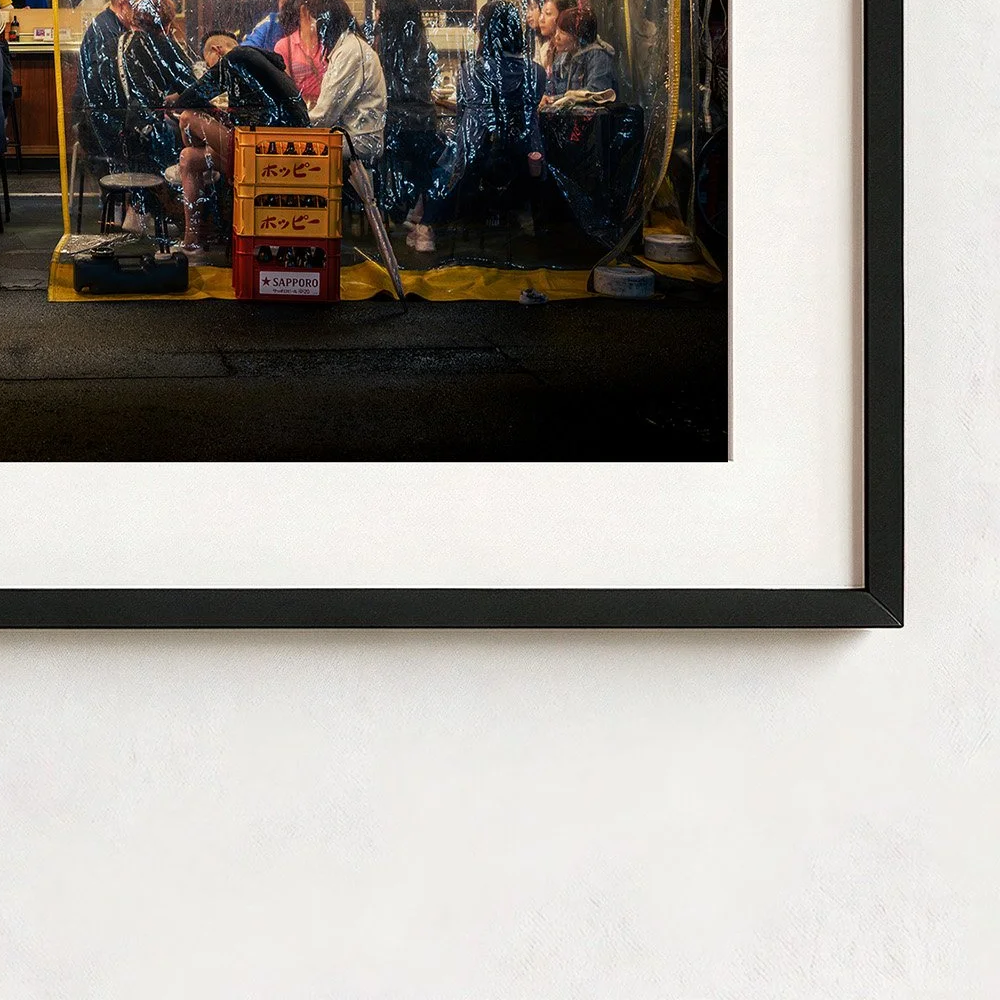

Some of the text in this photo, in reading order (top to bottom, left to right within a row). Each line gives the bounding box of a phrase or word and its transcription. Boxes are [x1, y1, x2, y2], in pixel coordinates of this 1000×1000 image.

[261, 161, 322, 179] ホッピー
[260, 214, 321, 231] ホッピー
[272, 277, 319, 288] SAPPORO
